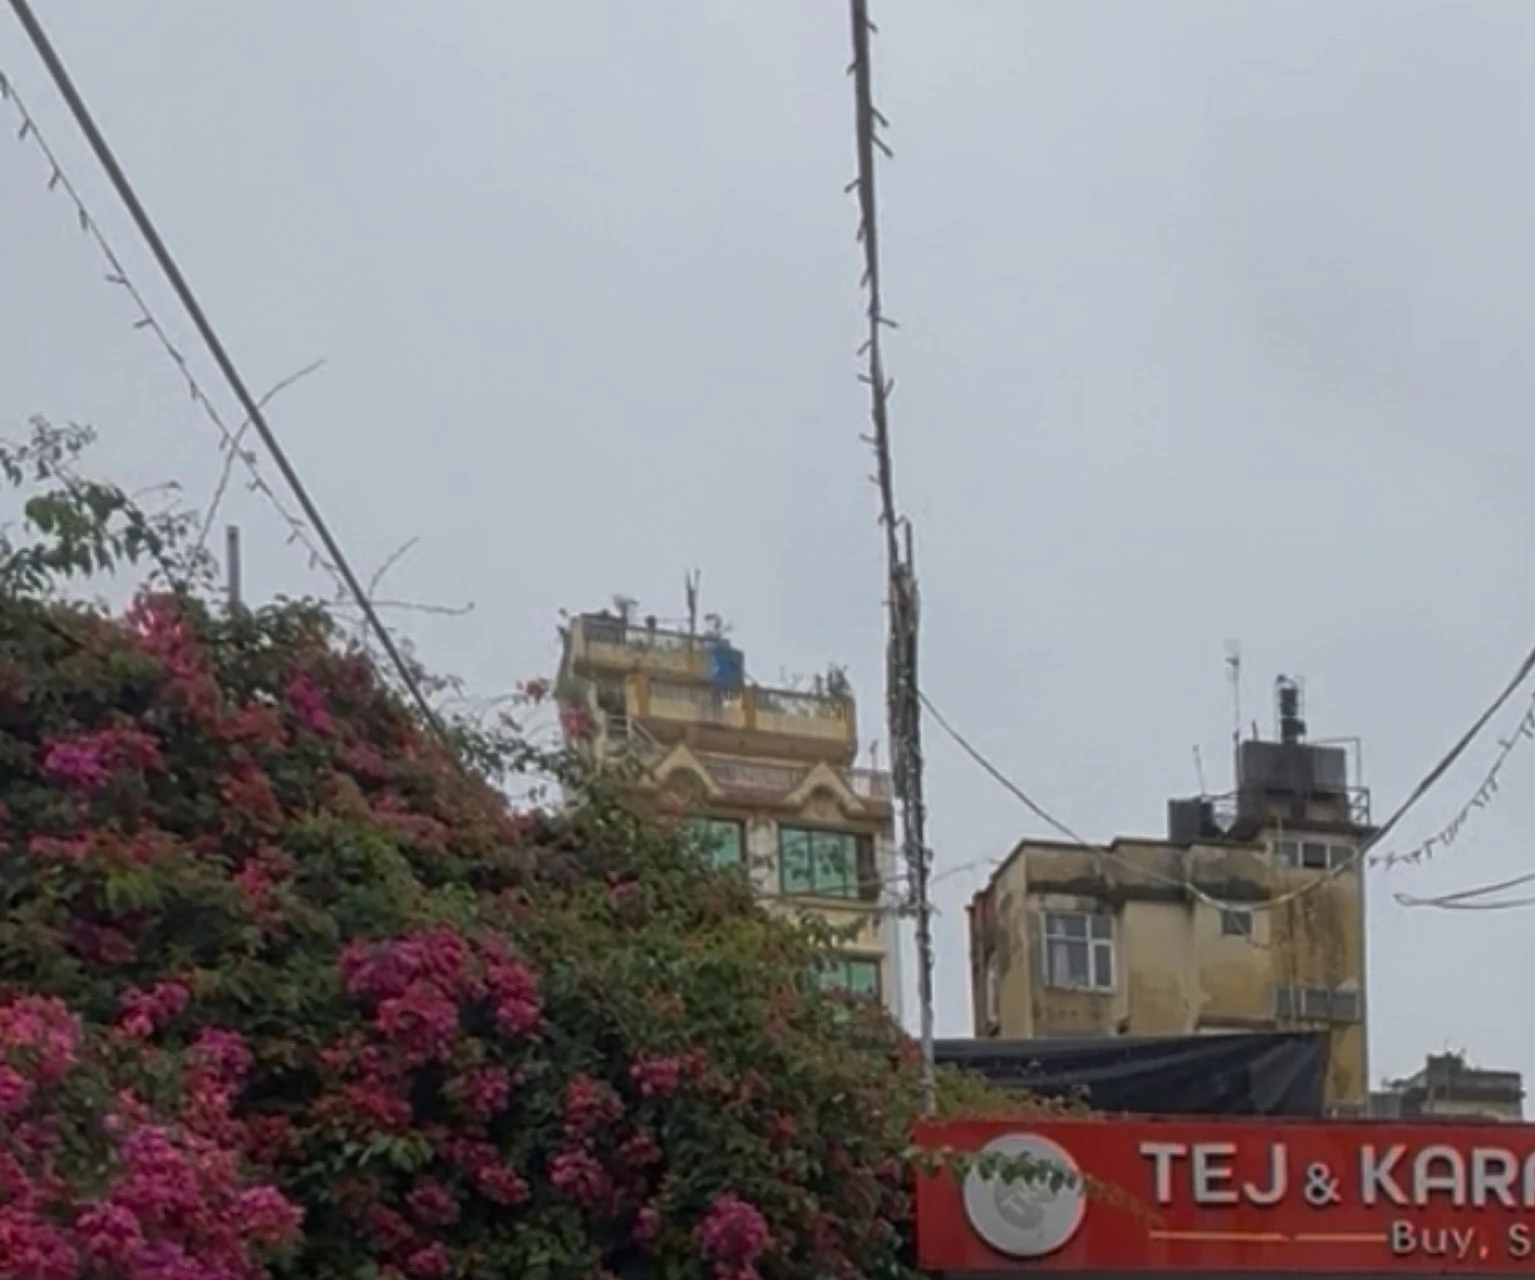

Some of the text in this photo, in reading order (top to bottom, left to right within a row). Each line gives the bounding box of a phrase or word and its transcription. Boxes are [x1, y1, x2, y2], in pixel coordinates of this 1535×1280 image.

[1140, 1143, 1288, 1205] TEJ
[1304, 1162, 1341, 1207] &
[1391, 1222, 1490, 1260] Buy,
